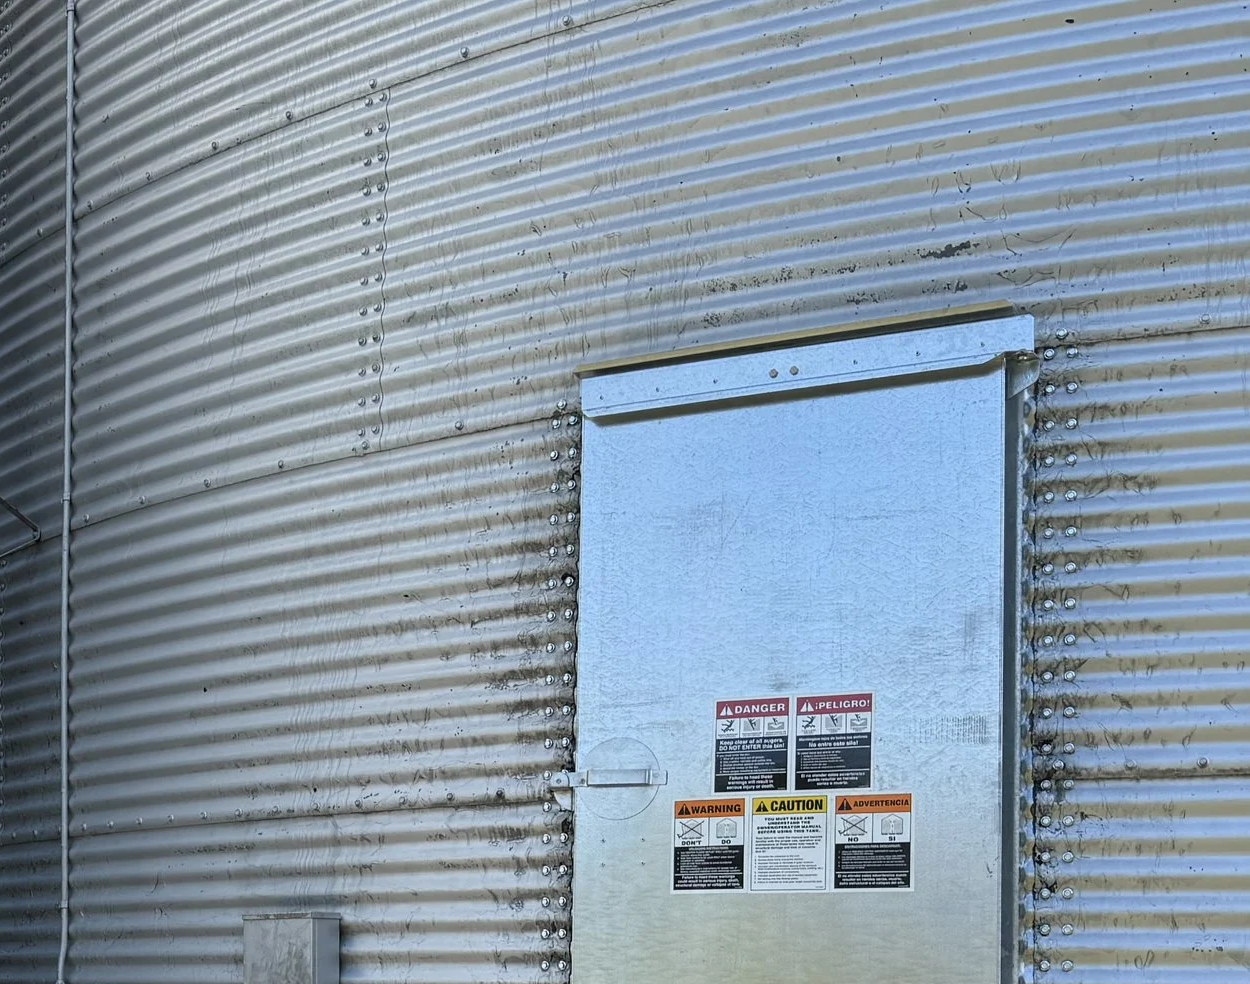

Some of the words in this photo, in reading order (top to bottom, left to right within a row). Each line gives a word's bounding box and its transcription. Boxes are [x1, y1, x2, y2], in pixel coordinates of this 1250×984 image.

[735, 704, 785, 714] DANGER
[816, 700, 870, 710] ¡PELIGRO!
[691, 804, 741, 814] WARNING
[771, 799, 823, 811] CAUTION
